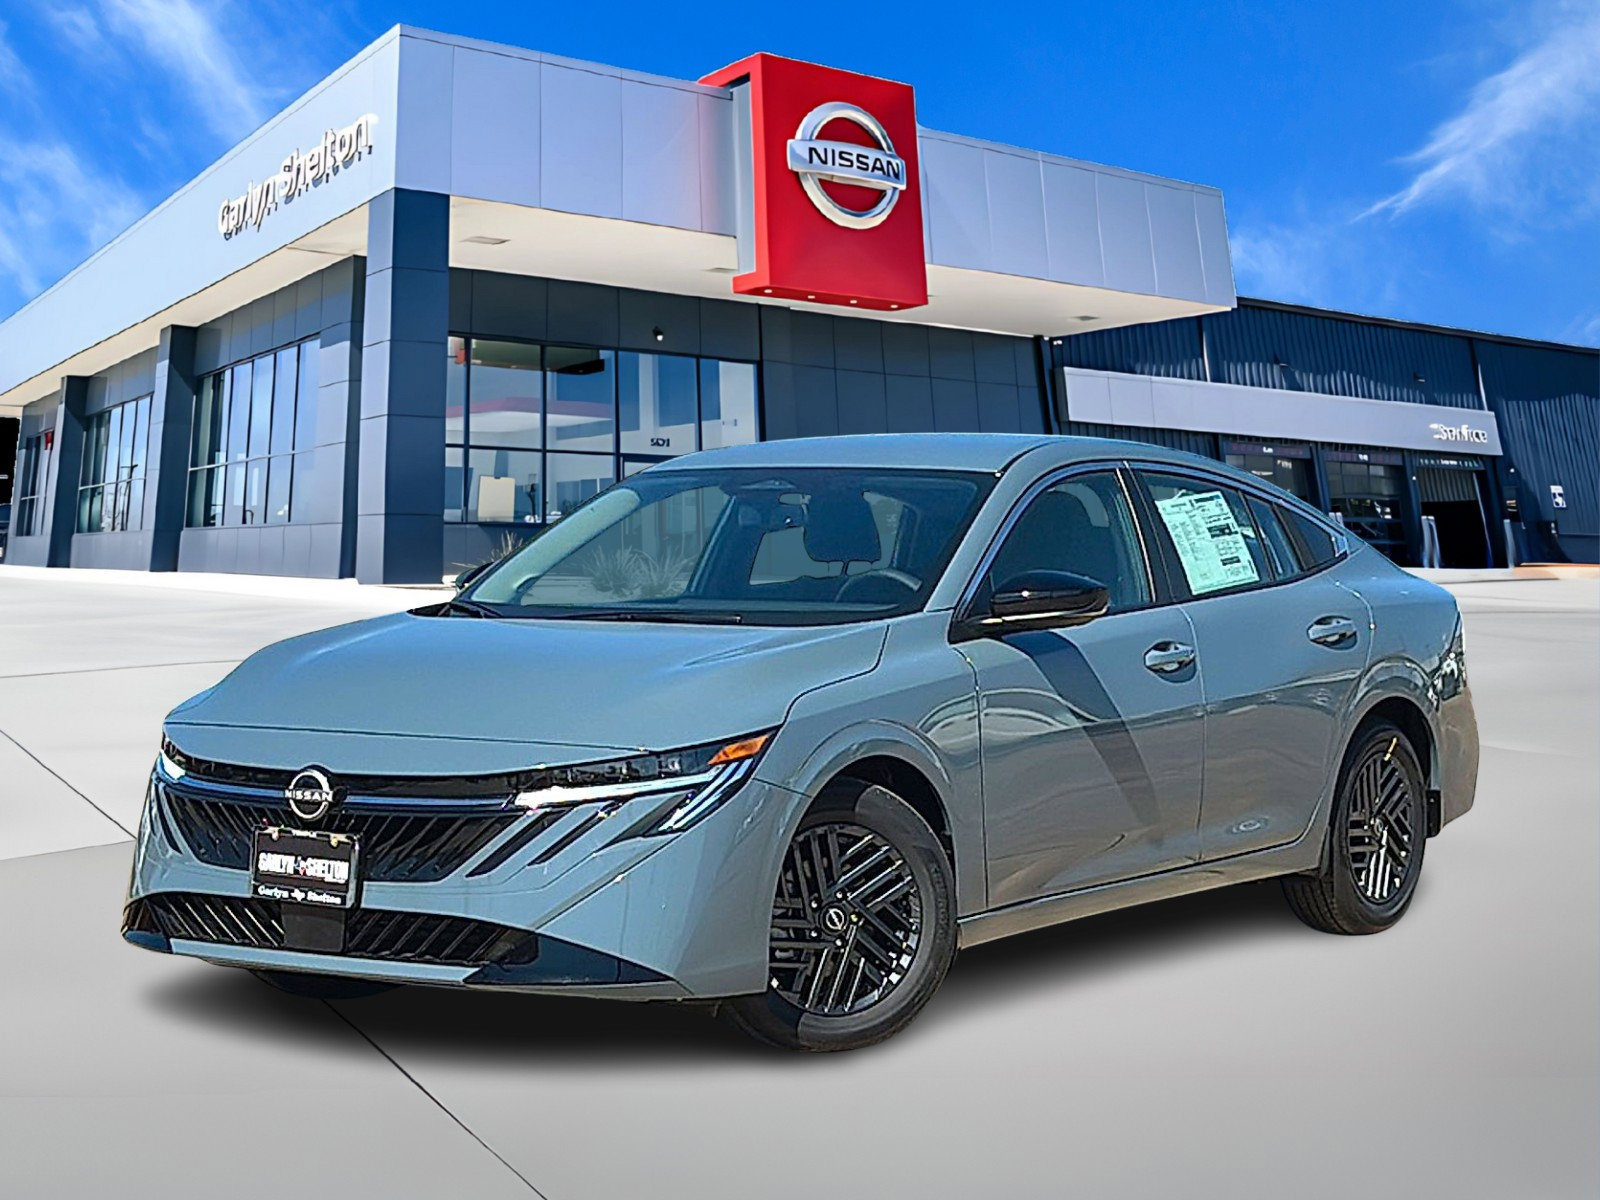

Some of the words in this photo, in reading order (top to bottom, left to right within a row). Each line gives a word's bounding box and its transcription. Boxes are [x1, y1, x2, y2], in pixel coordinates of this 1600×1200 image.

[278, 116, 372, 202] Shelton
[808, 146, 901, 181] NISSAN
[284, 788, 334, 803] NISSAN
